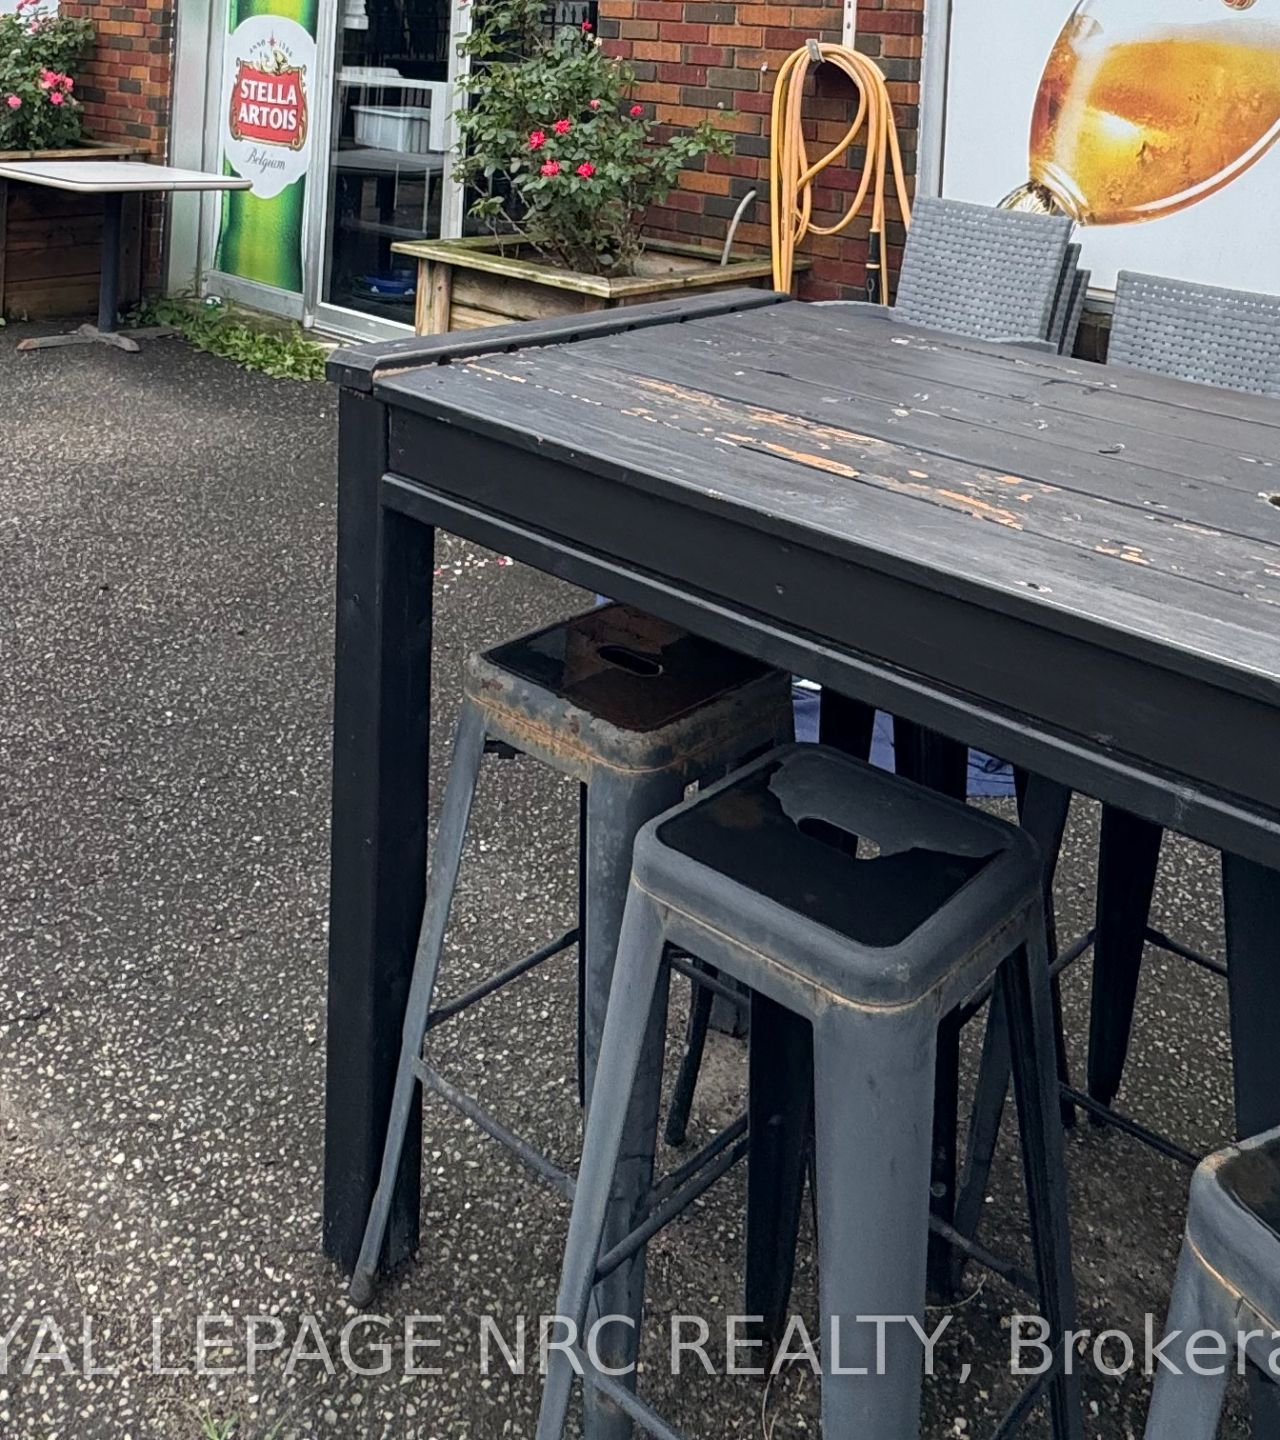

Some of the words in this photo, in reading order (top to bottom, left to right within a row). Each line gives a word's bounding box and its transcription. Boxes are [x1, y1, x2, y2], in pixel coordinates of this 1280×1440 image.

[240, 79, 298, 105] STELLA
[238, 102, 297, 131] ARTOIS
[244, 146, 286, 173] Belgium
